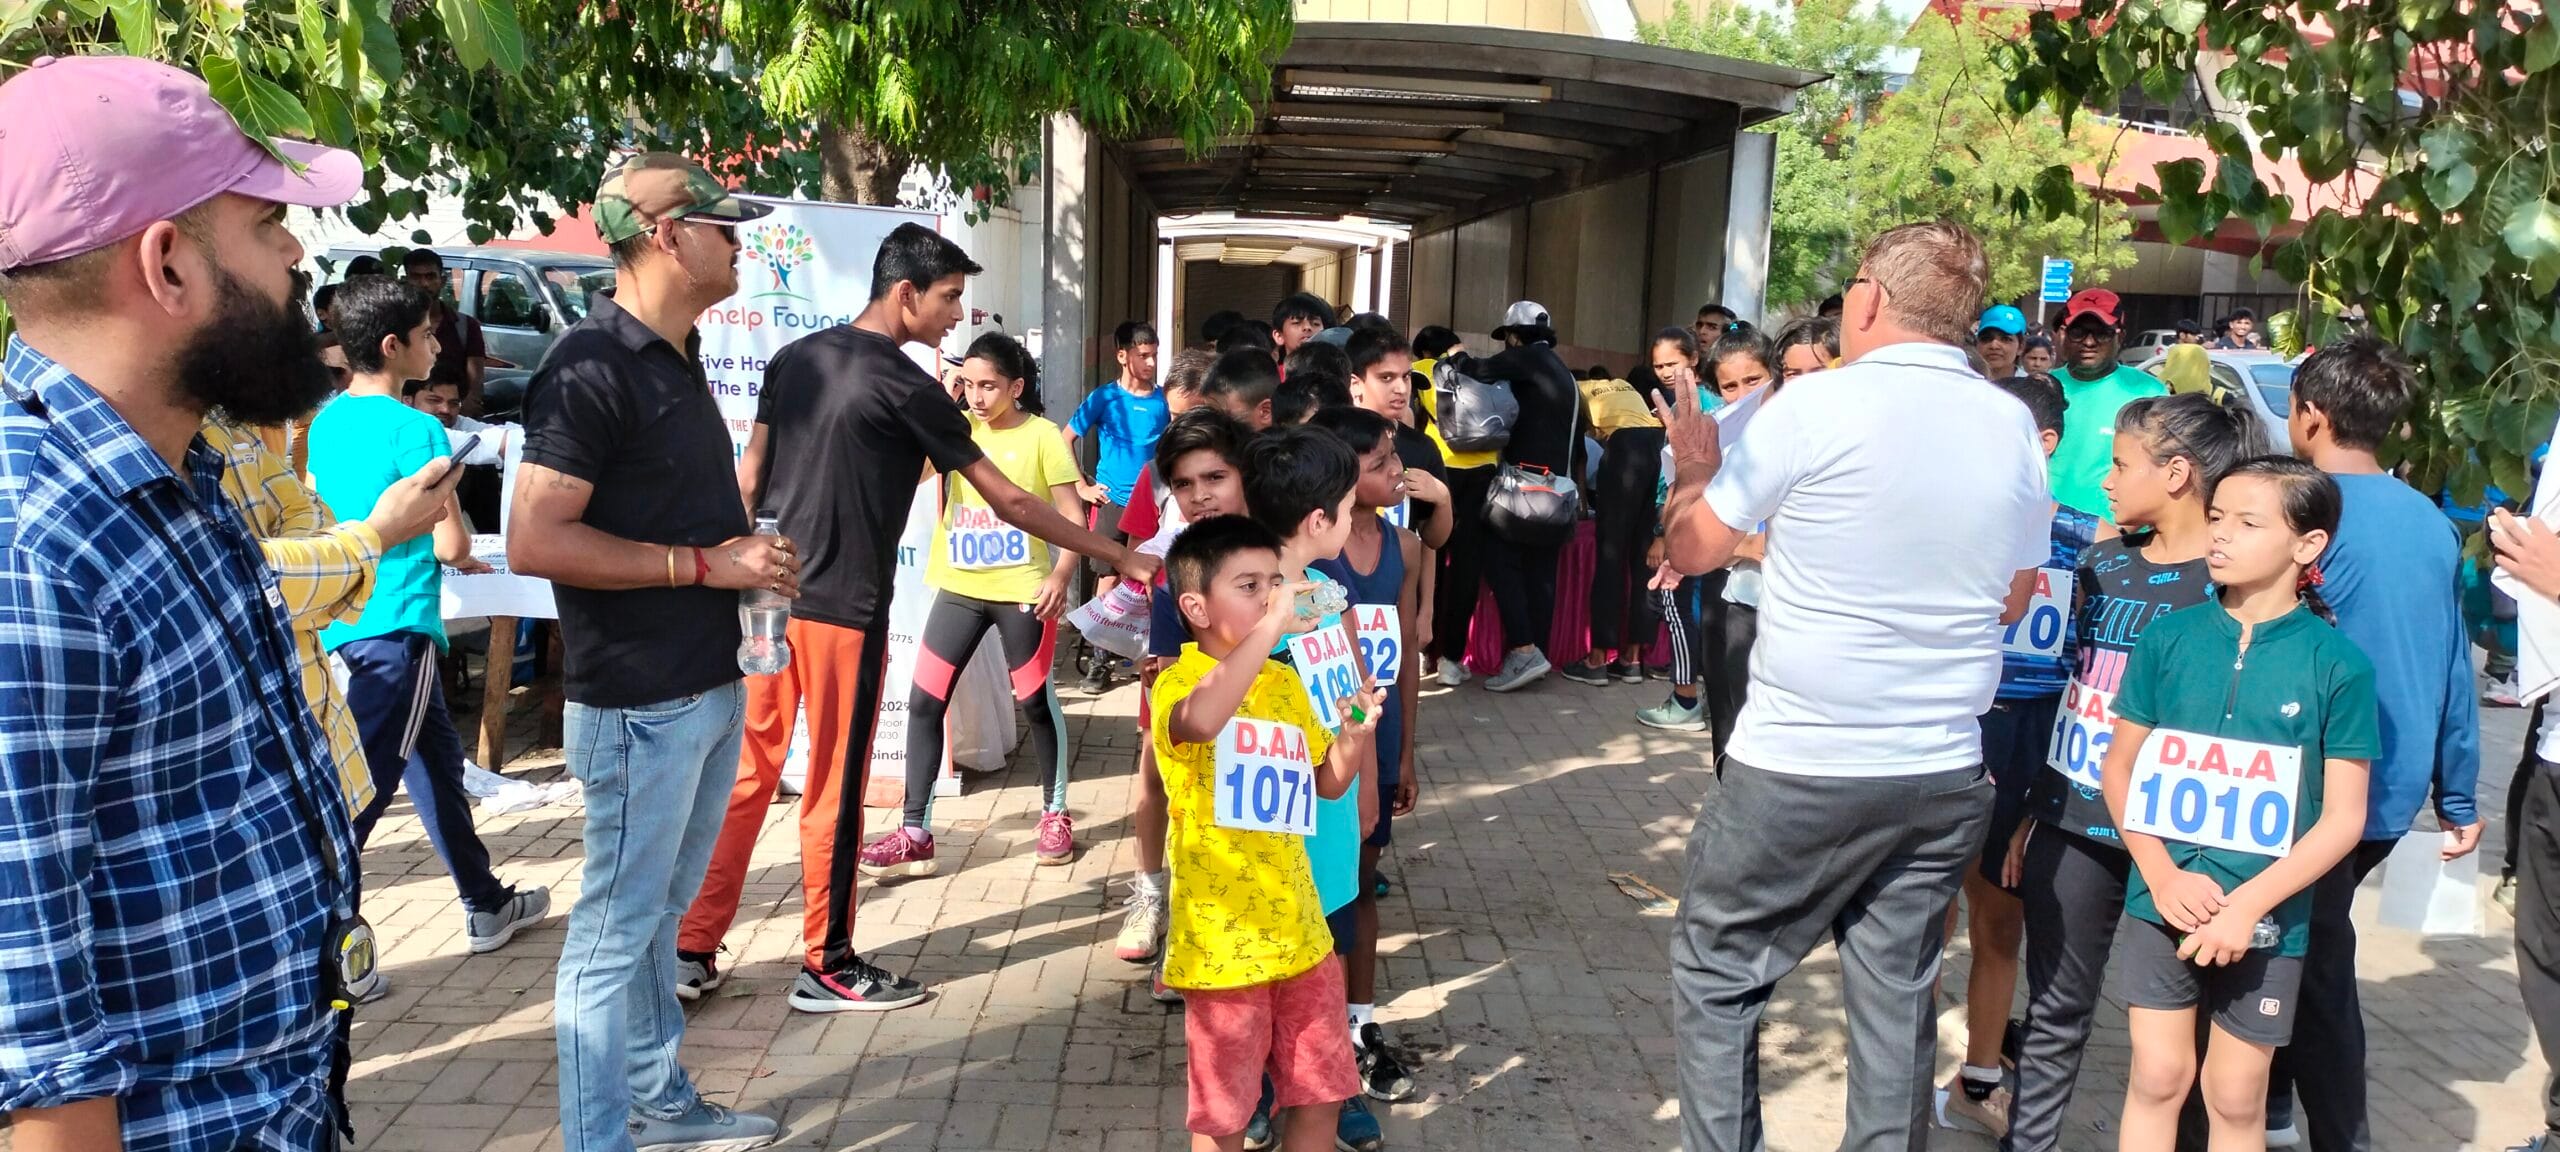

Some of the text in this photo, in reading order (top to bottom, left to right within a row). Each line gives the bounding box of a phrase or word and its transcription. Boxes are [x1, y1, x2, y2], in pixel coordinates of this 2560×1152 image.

[708, 380, 741, 396] The
[1301, 628, 1349, 666] D.A.A
[1235, 721, 1307, 764] D.A.A
[2159, 735, 2277, 783] D.A.A
[1226, 763, 1313, 827] 1071
[2139, 772, 2289, 848] 1010
